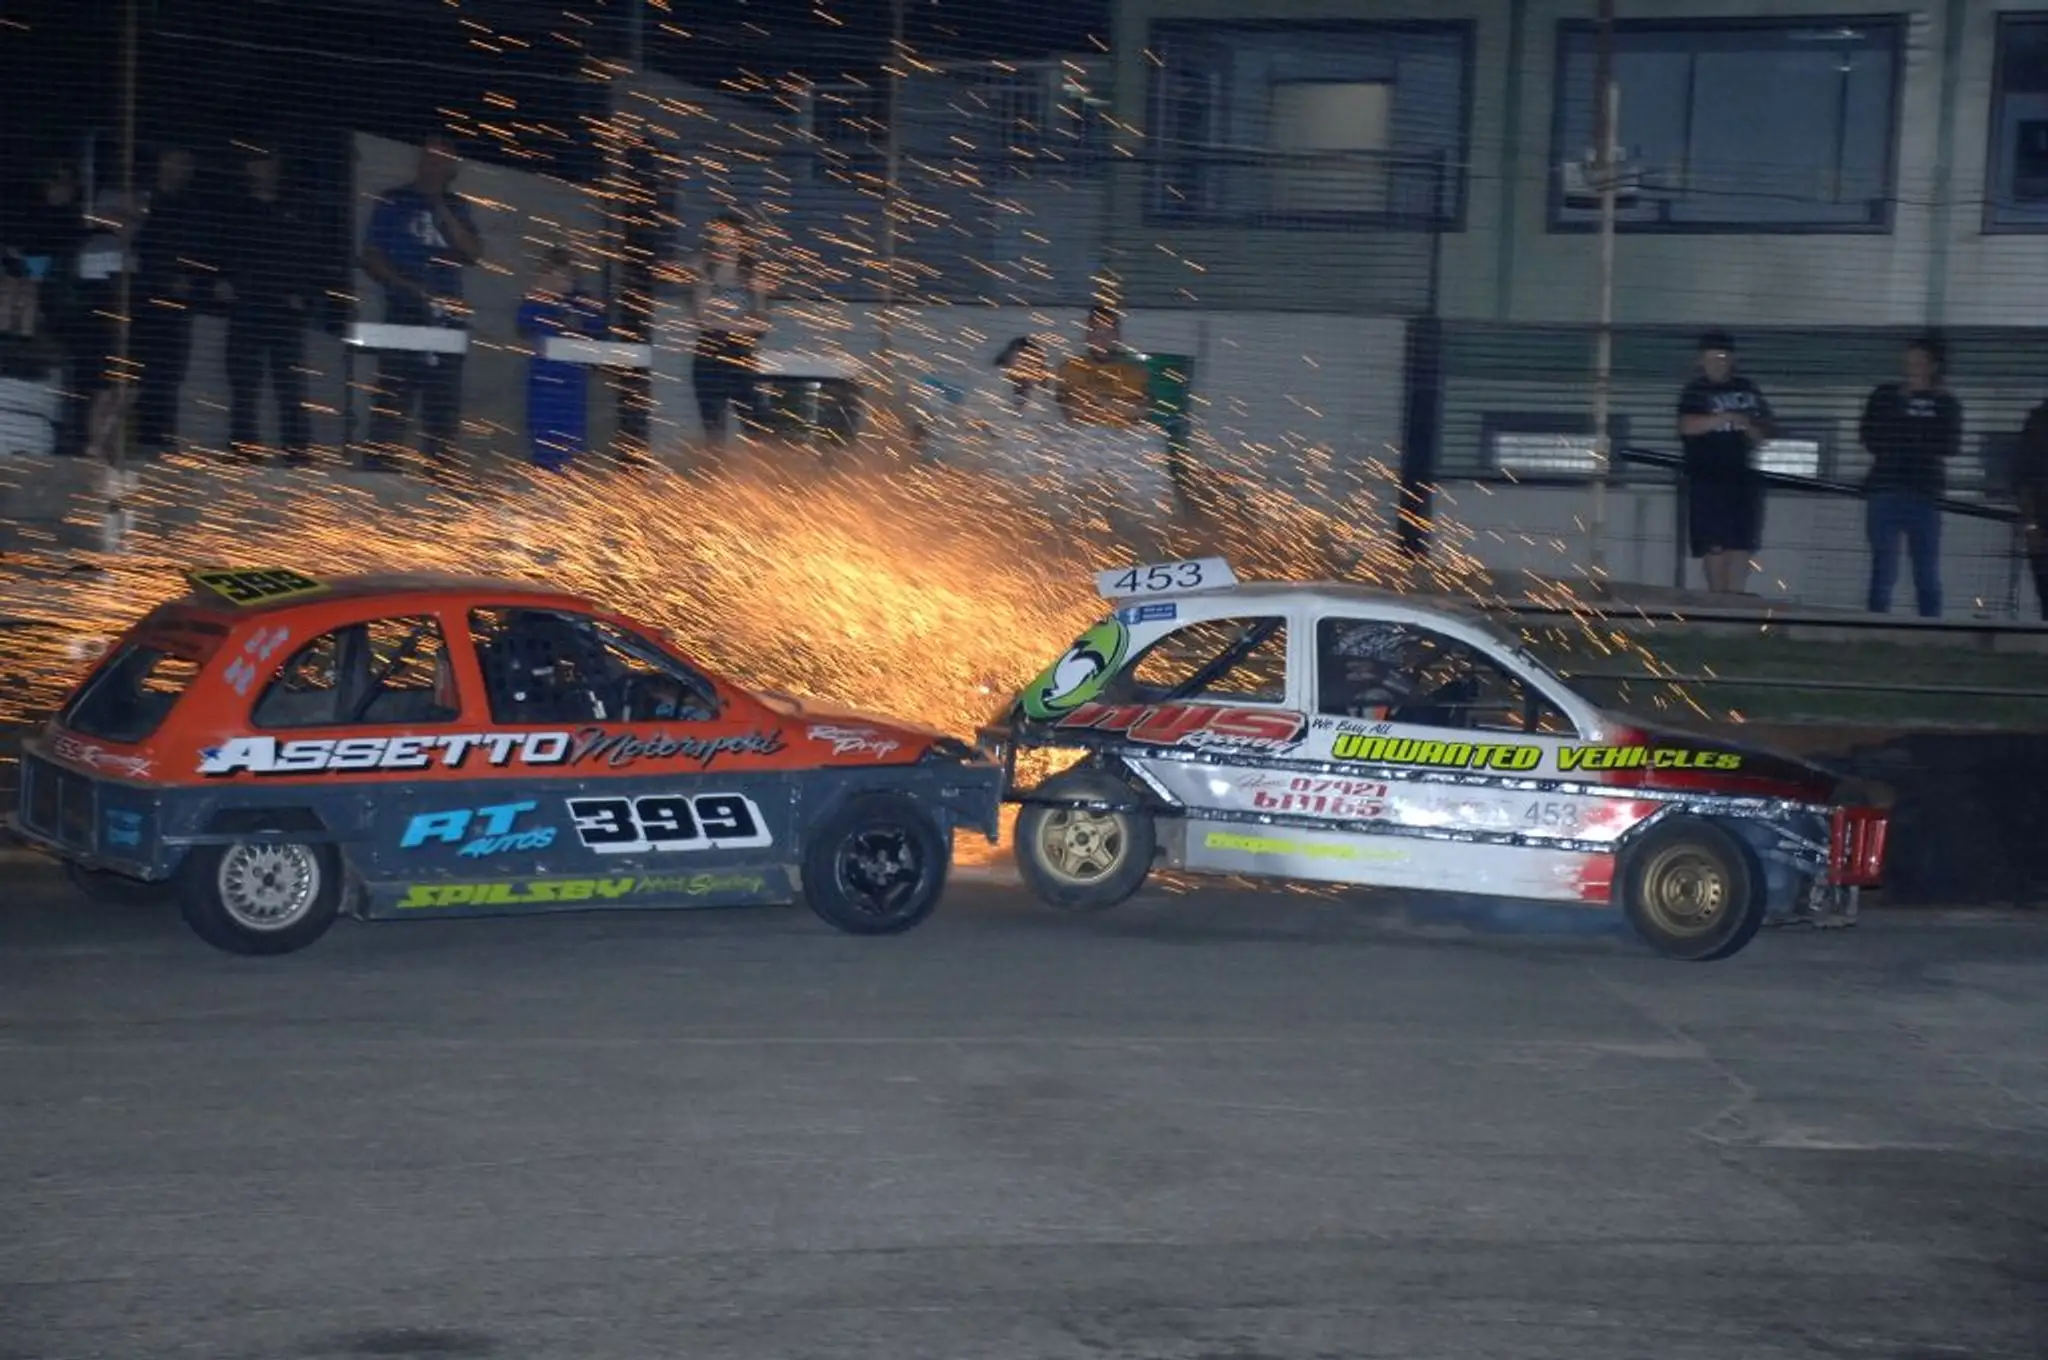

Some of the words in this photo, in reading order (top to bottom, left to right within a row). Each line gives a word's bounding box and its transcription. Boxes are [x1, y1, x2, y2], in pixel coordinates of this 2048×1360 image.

[1113, 562, 1203, 593] 453
[1312, 718, 1334, 730] We
[1336, 721, 1365, 735] Buy
[196, 731, 572, 777] ASSETTO
[1331, 732, 1543, 770] UNWANTED
[1557, 745, 1742, 772] VEHICLES
[566, 792, 774, 853] 399
[1524, 801, 1579, 827] 453
[397, 878, 636, 908] SPILSBY
